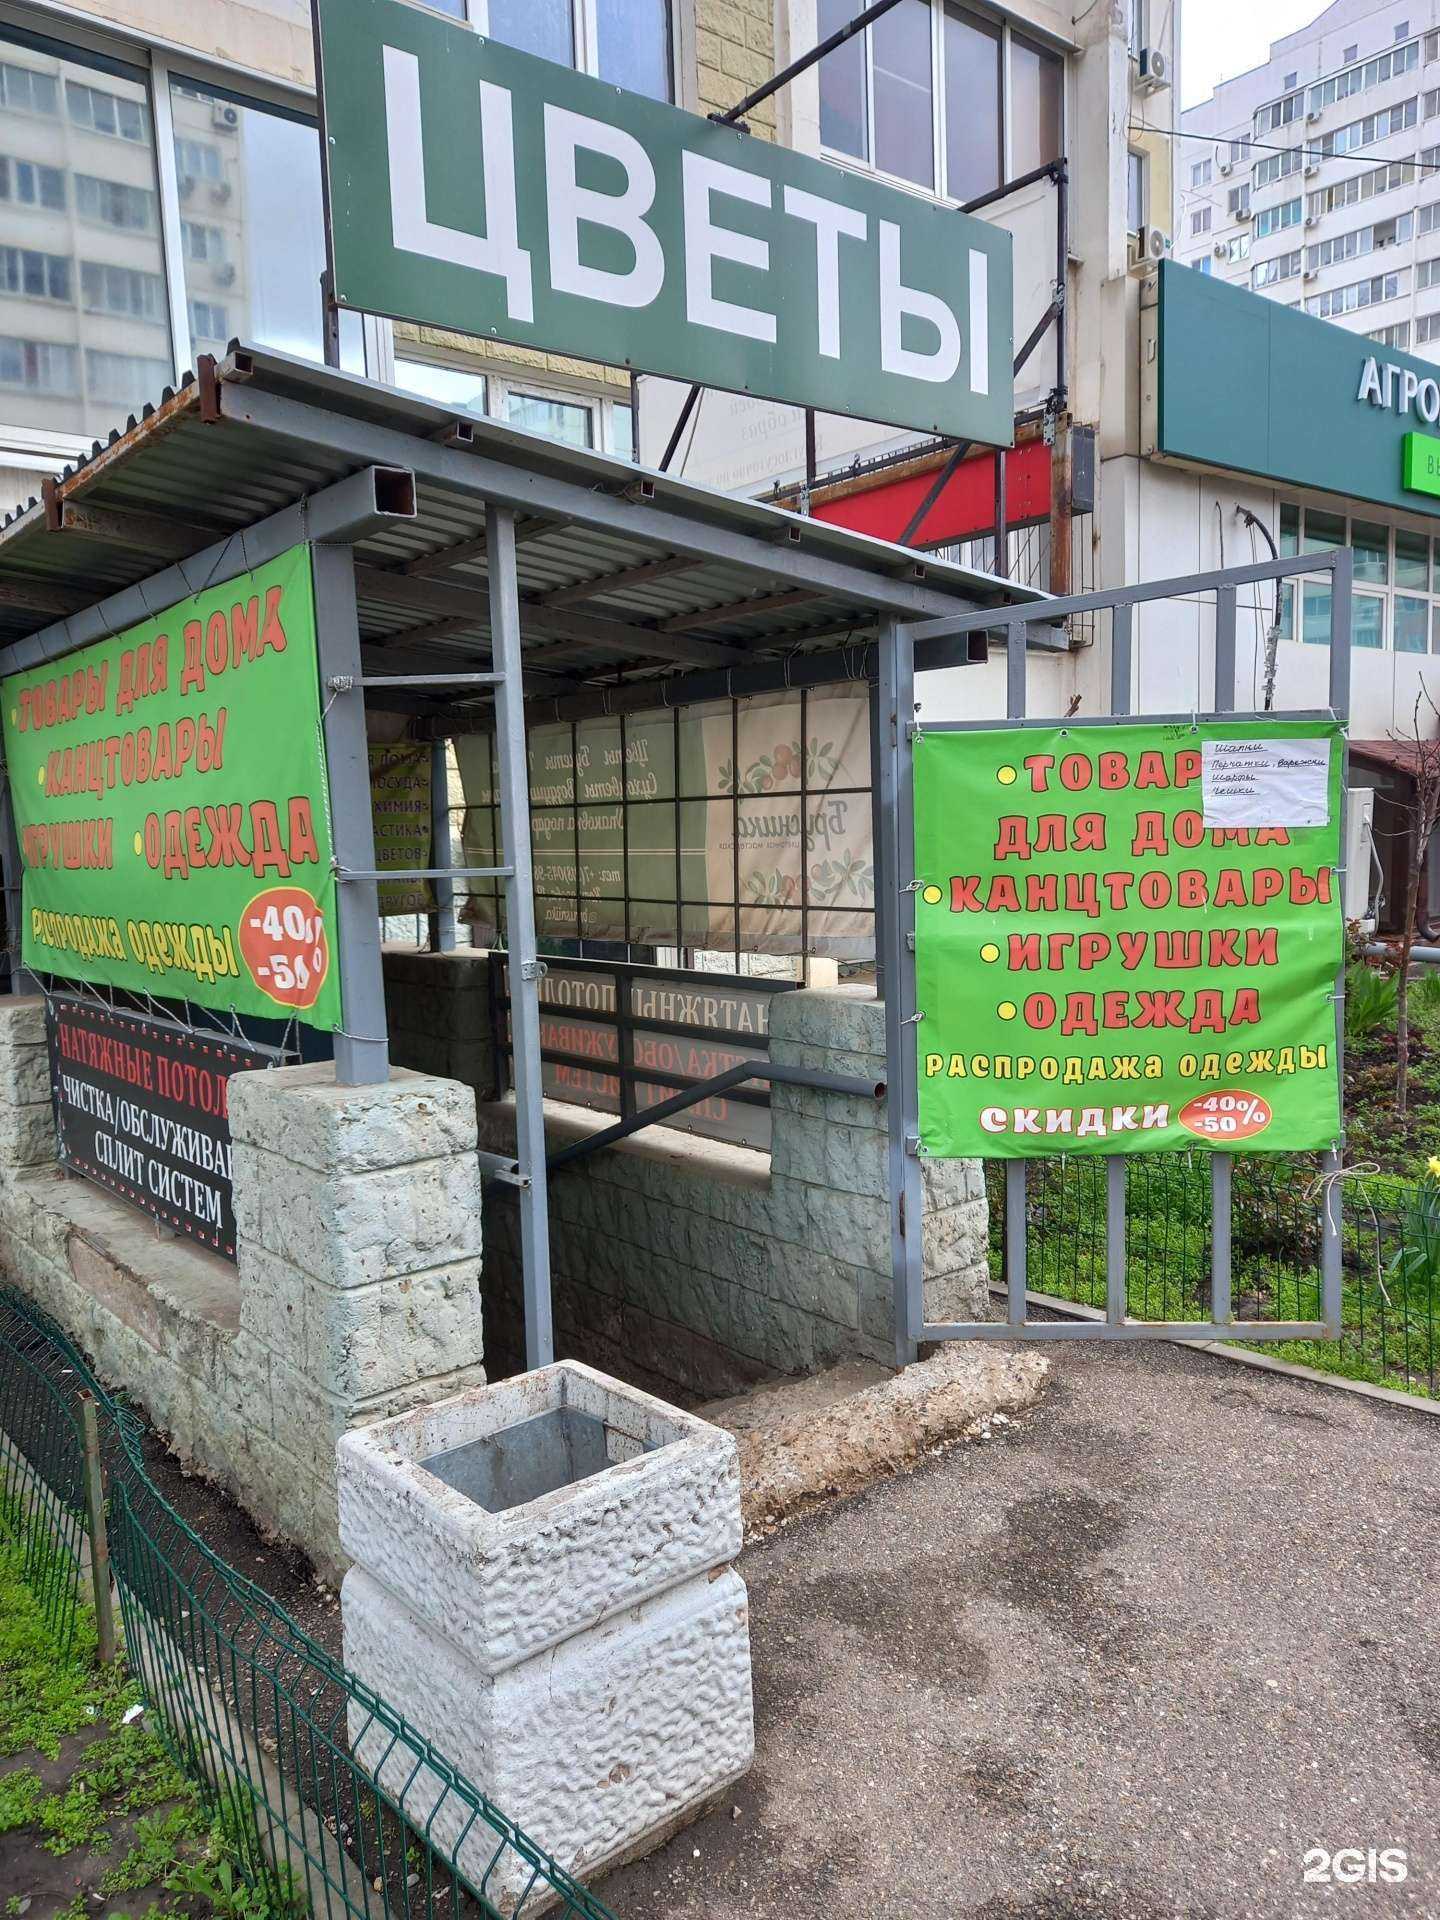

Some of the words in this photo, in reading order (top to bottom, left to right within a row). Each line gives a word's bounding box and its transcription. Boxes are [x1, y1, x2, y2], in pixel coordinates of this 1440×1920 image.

[382, 44, 990, 396] ЦВЕТЫ
[18, 659, 109, 733] ТОВАРЫ
[115, 633, 169, 716] ДЛЯ
[179, 585, 288, 697] ДОМА
[45, 706, 228, 800] КАНЦТОВАРЫ
[144, 796, 319, 880] ОДЕЖДА
[993, 812, 1107, 860] ДЛЯ
[949, 866, 1333, 918] КАНЦТОВАРЫ
[1007, 927, 1280, 971] ИГРУШКИ
[1023, 988, 1262, 1037] ОДЕЖДА
[60, 1023, 153, 1091] НАТЯЖНЫЕ
[95, 1130, 145, 1186] СПЛИТ
[149, 1159, 223, 1229] СИСТЕМ
